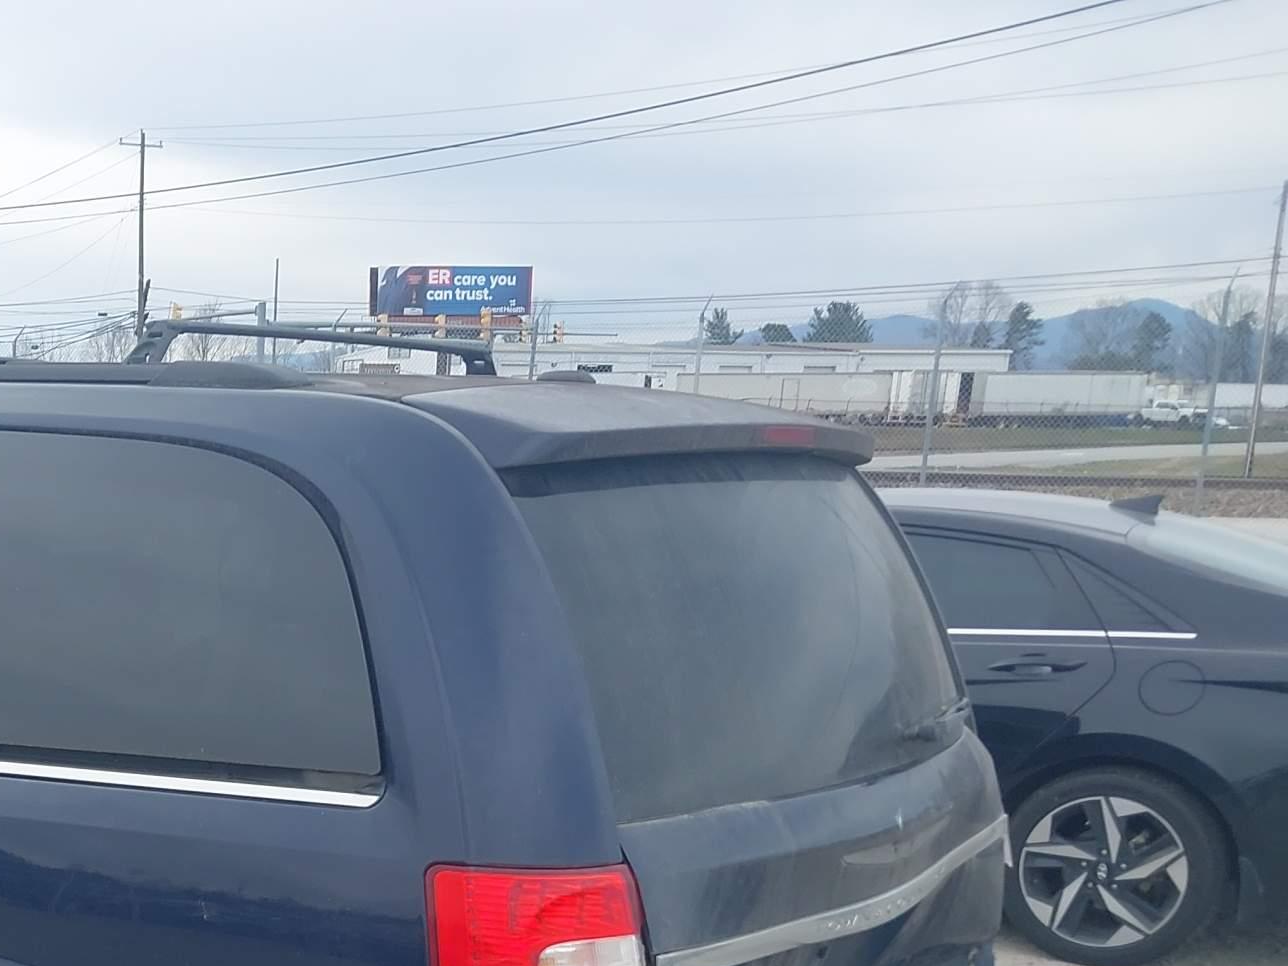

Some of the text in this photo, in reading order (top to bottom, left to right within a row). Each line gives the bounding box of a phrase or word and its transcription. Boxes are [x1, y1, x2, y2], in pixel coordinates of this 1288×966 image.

[428, 269, 451, 285] ER
[454, 275, 486, 286] care
[490, 274, 517, 289] you
[426, 288, 493, 301] can trust.
